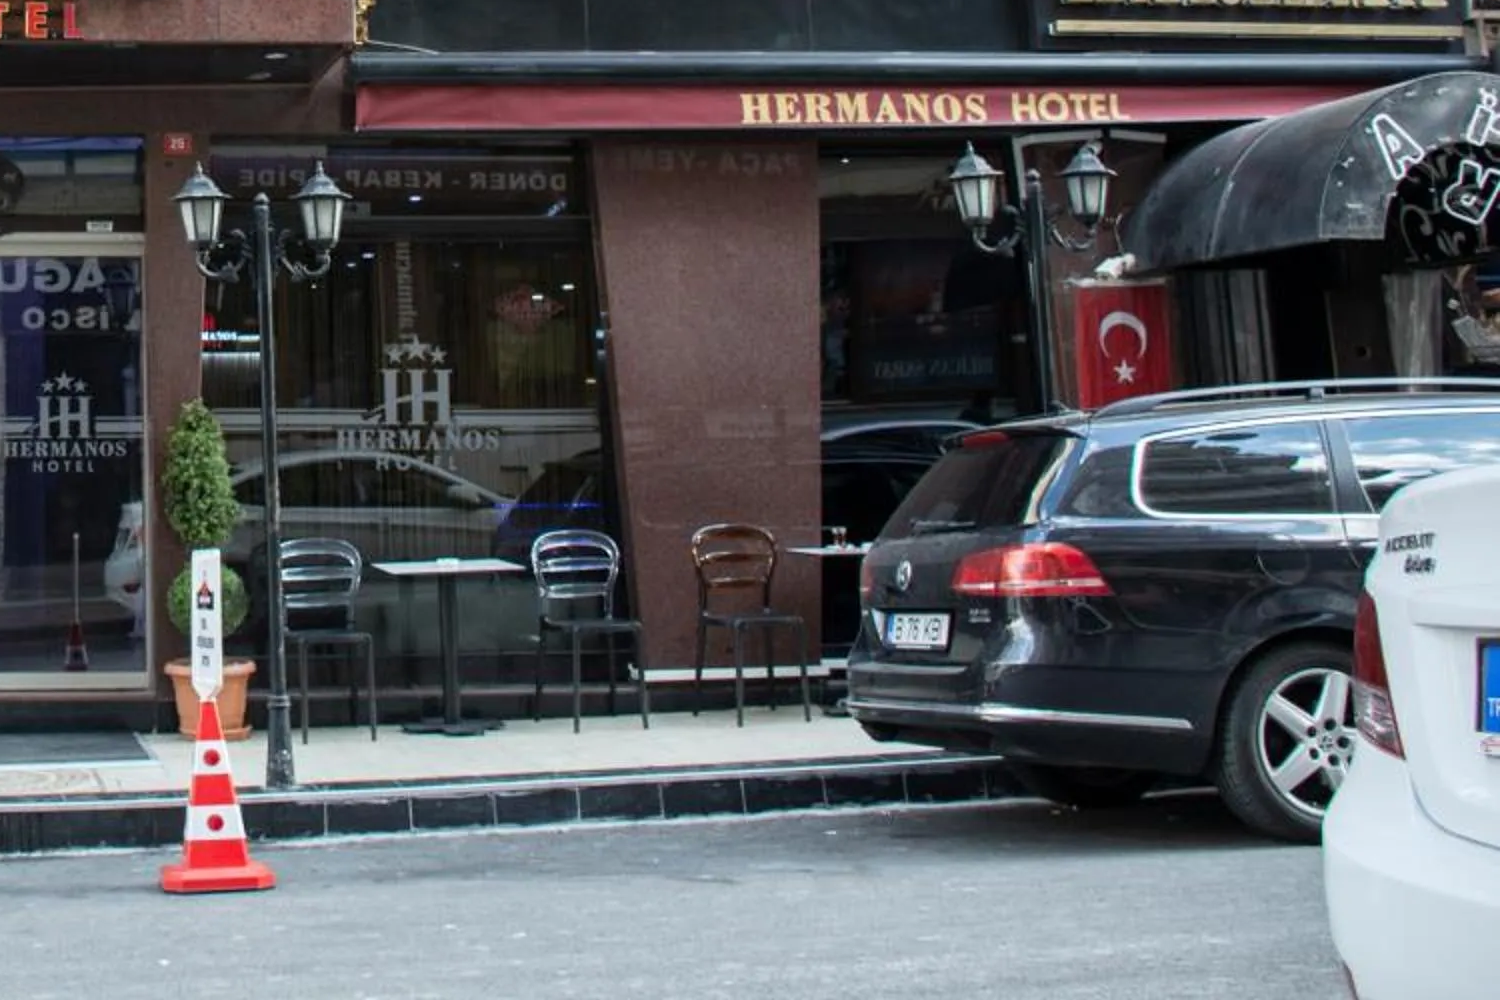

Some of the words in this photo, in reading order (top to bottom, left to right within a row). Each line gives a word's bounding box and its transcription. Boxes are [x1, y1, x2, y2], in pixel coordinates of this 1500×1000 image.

[740, 92, 988, 125] HERMANOS
[1011, 92, 1130, 122] HOTEL
[4, 440, 128, 458] HERMANOS
[337, 428, 500, 453] HERMANOS
[33, 459, 96, 473] HOTEL
